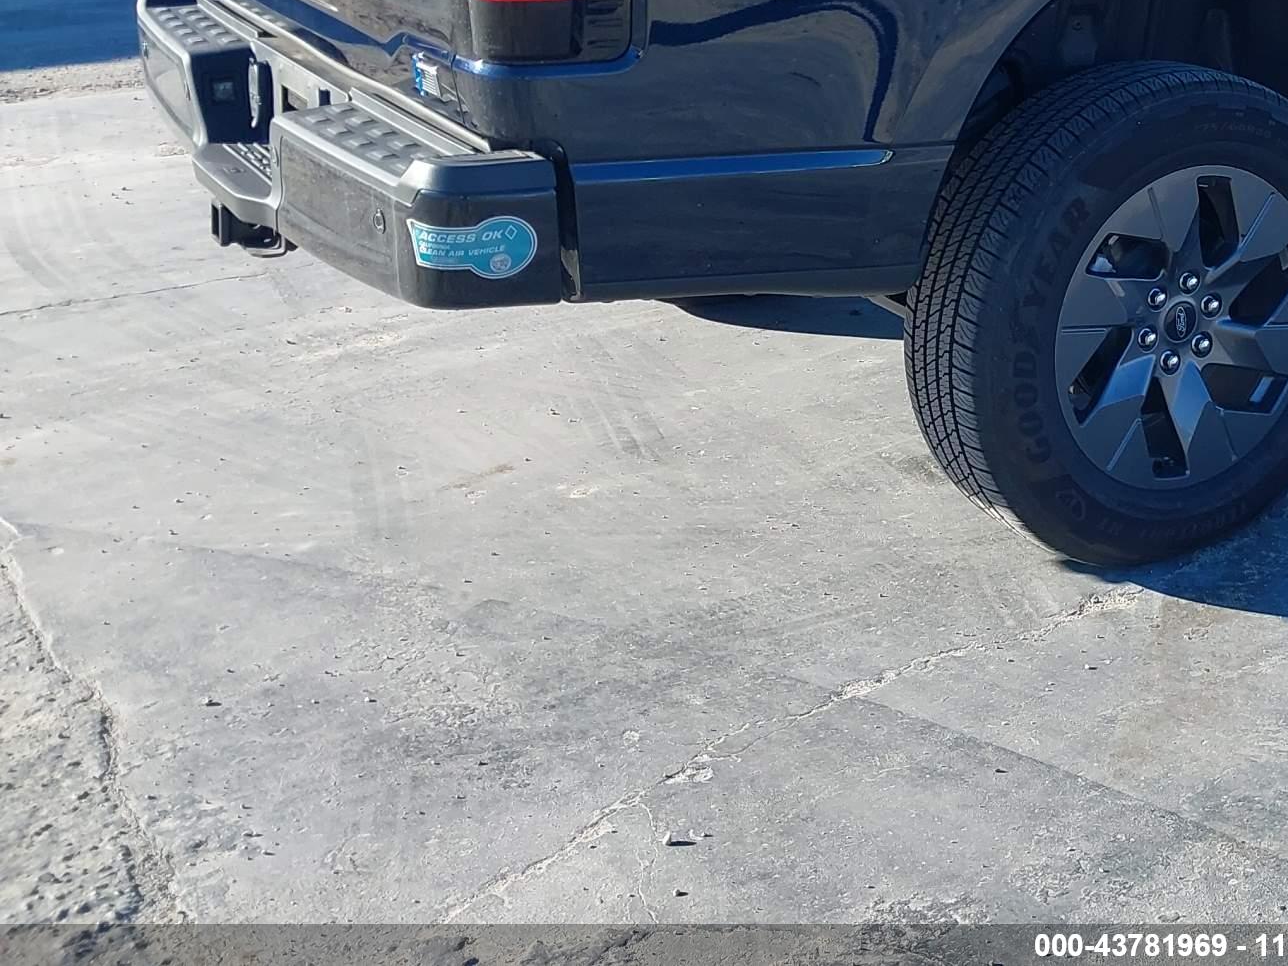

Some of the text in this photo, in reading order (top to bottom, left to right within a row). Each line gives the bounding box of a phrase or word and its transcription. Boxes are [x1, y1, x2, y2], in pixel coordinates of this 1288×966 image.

[419, 229, 504, 244] ACCESS OK
[419, 245, 505, 257] CLEAN AIR VEHICLE
[1011, 196, 1092, 465] GOODYEAR
